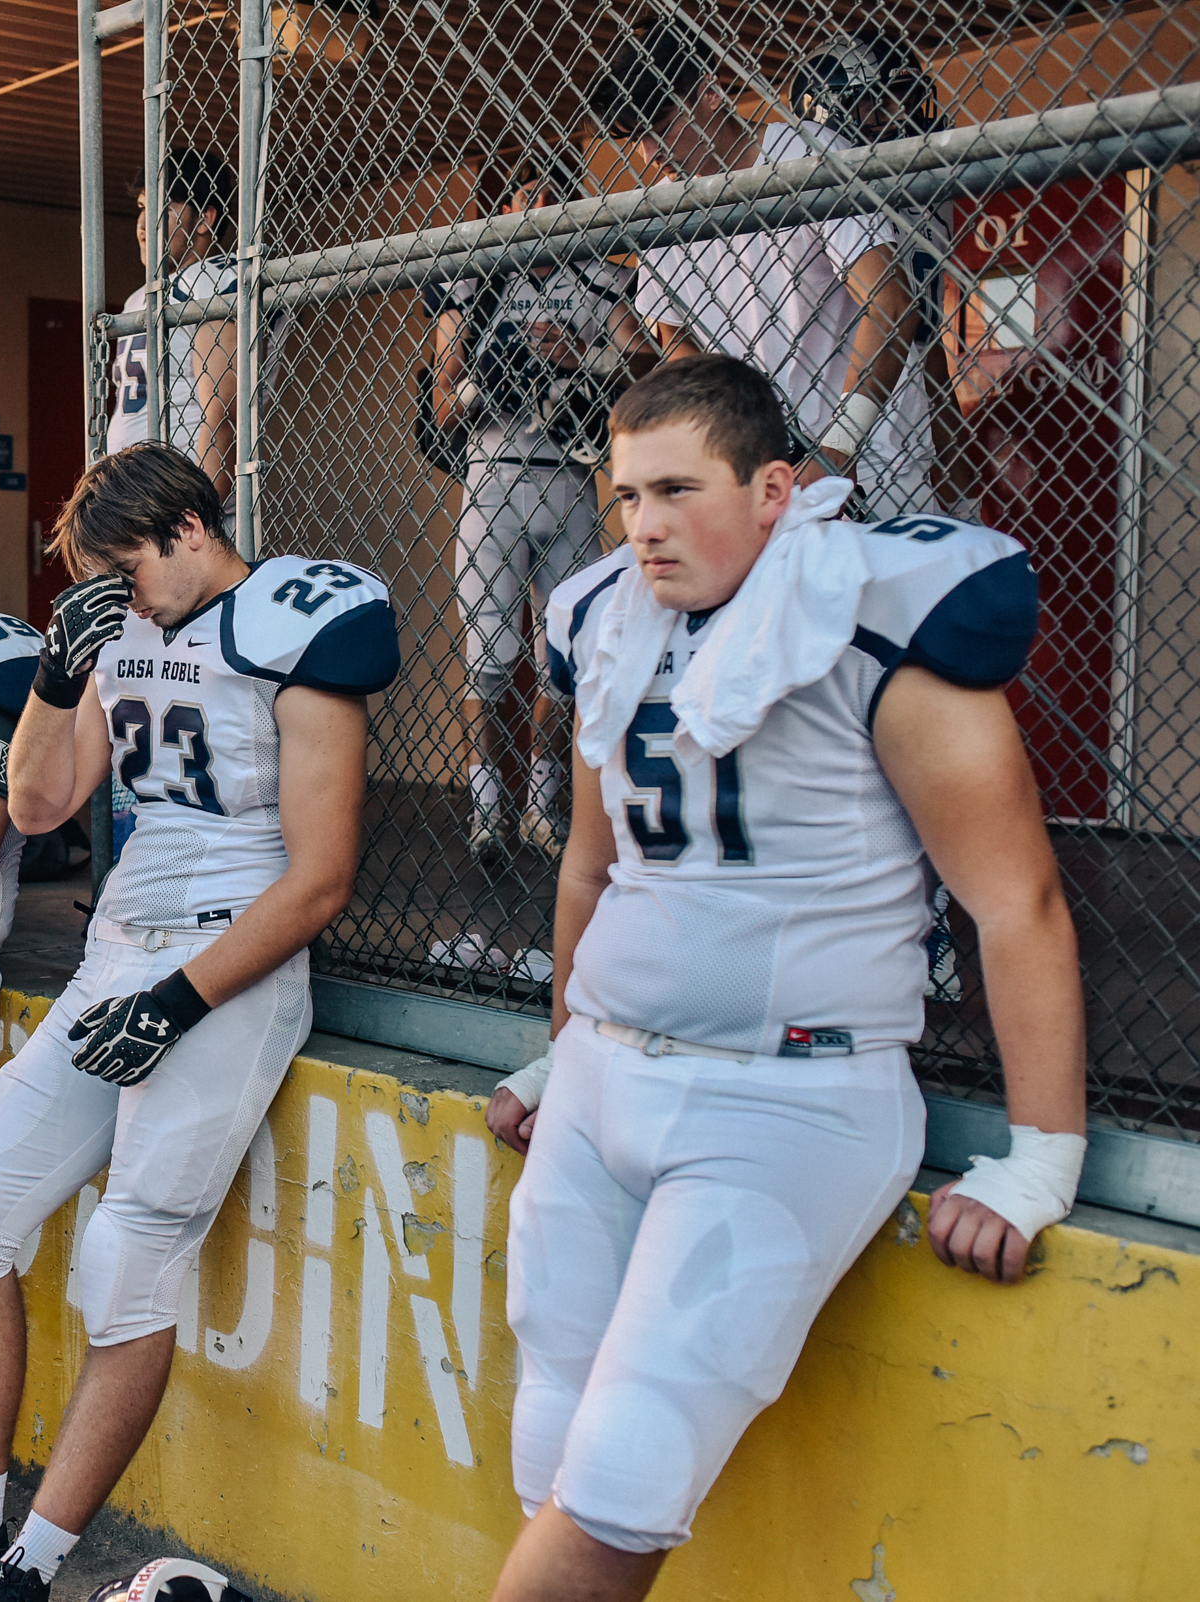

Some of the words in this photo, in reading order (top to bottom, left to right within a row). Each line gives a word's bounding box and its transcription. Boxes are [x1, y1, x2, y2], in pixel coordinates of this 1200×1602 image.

[271, 563, 364, 618] 23
[117, 658, 153, 678] CASA
[161, 660, 200, 684] ROBLE
[110, 694, 230, 817] 23
[622, 697, 755, 867] 51
